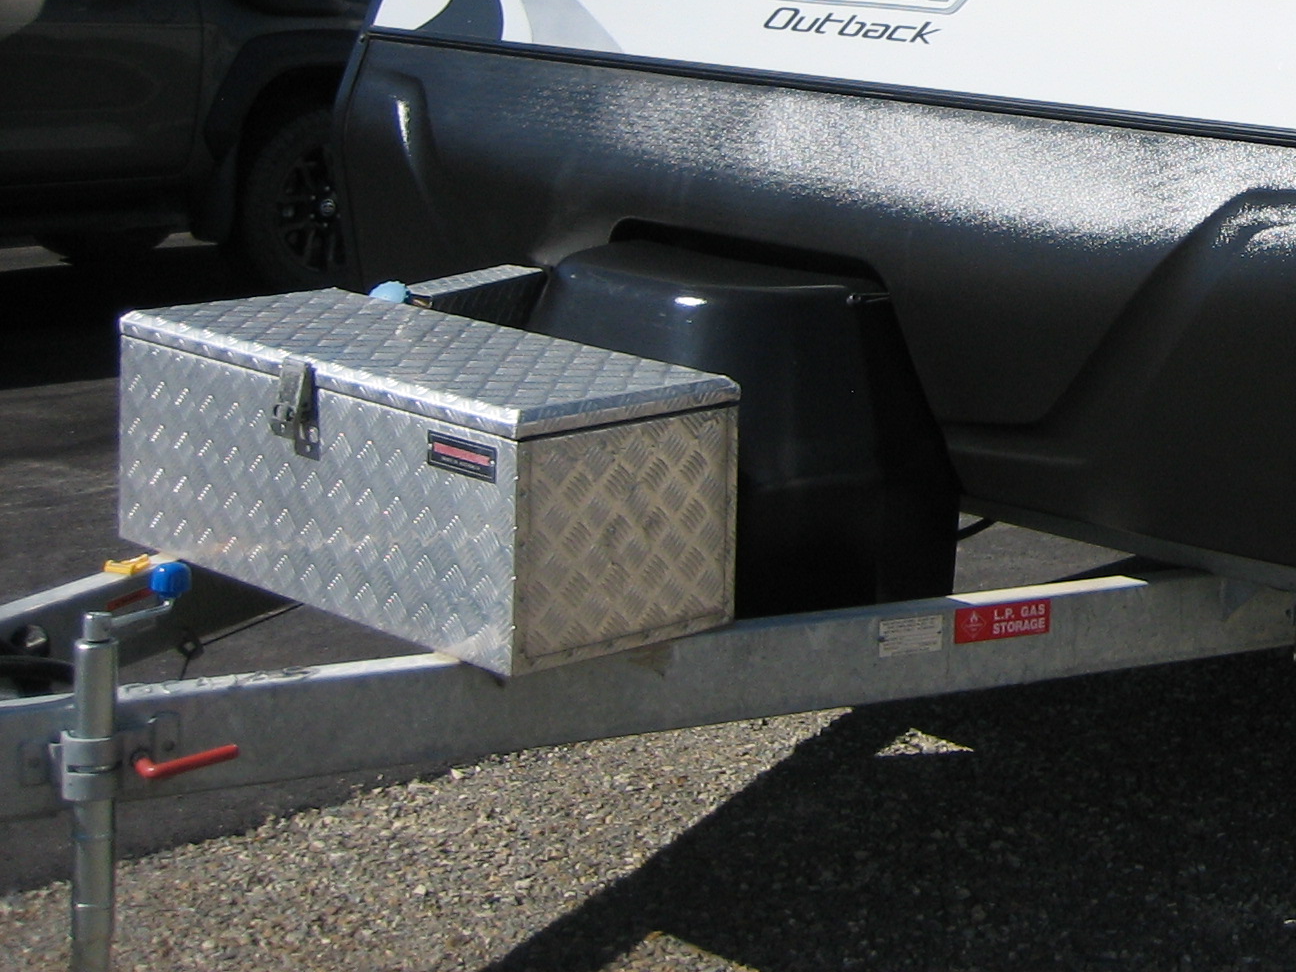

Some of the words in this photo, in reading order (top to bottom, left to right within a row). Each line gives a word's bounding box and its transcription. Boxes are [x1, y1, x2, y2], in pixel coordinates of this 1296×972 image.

[763, 7, 942, 44] Outback
[993, 608, 1015, 620] L.P.
[1020, 604, 1046, 618] GAS
[992, 618, 1046, 635] STORAGE
